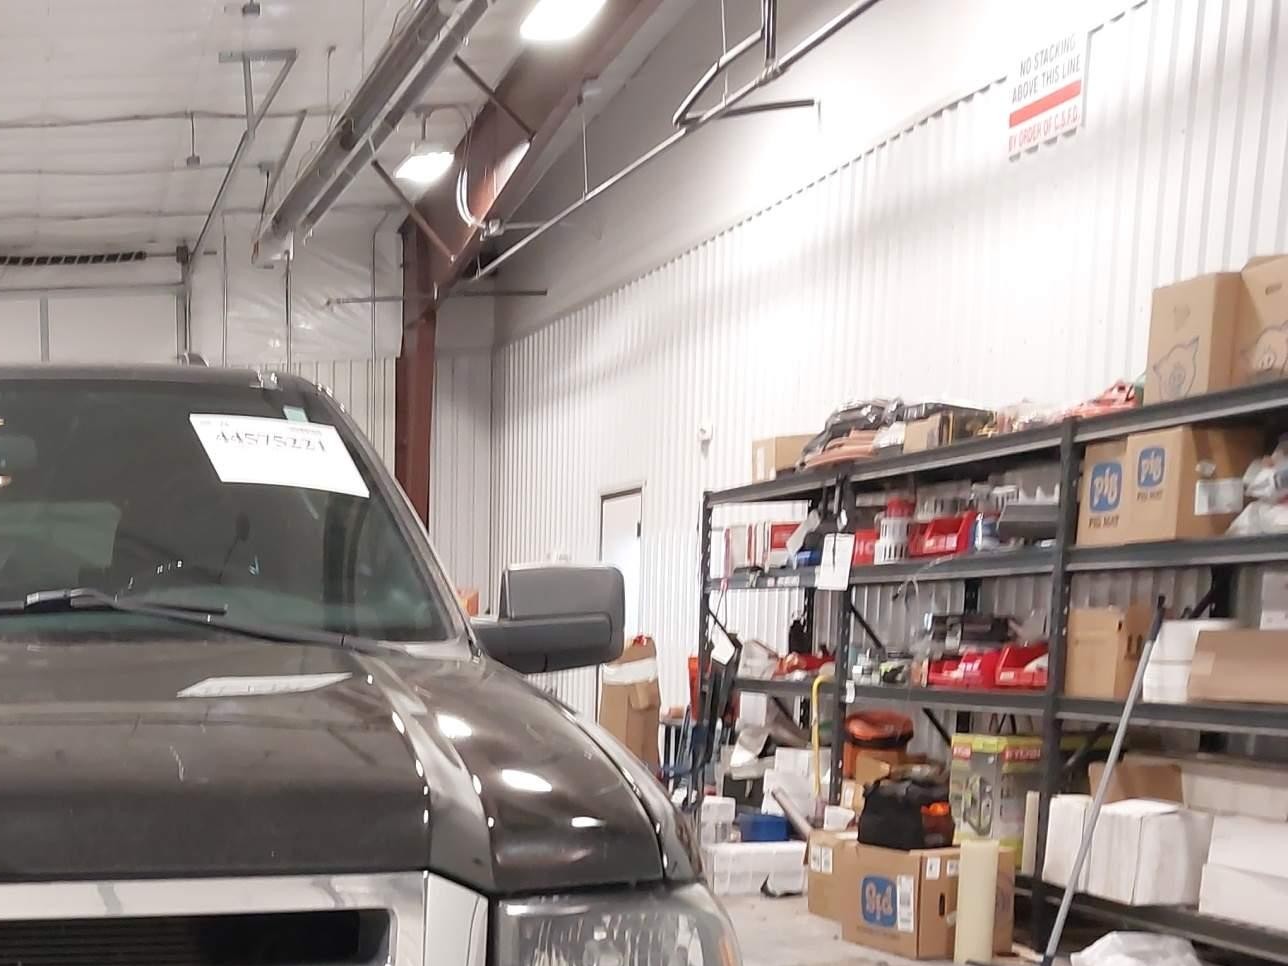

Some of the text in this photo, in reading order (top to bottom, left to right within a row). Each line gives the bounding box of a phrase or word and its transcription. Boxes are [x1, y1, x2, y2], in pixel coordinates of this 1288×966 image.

[1020, 34, 1076, 77] NO STACKING
[1012, 53, 1080, 104] ABOVE THIS LINE
[1009, 135, 1017, 152] BY
[1018, 121, 1042, 147] ORDER
[1043, 115, 1052, 137] OF
